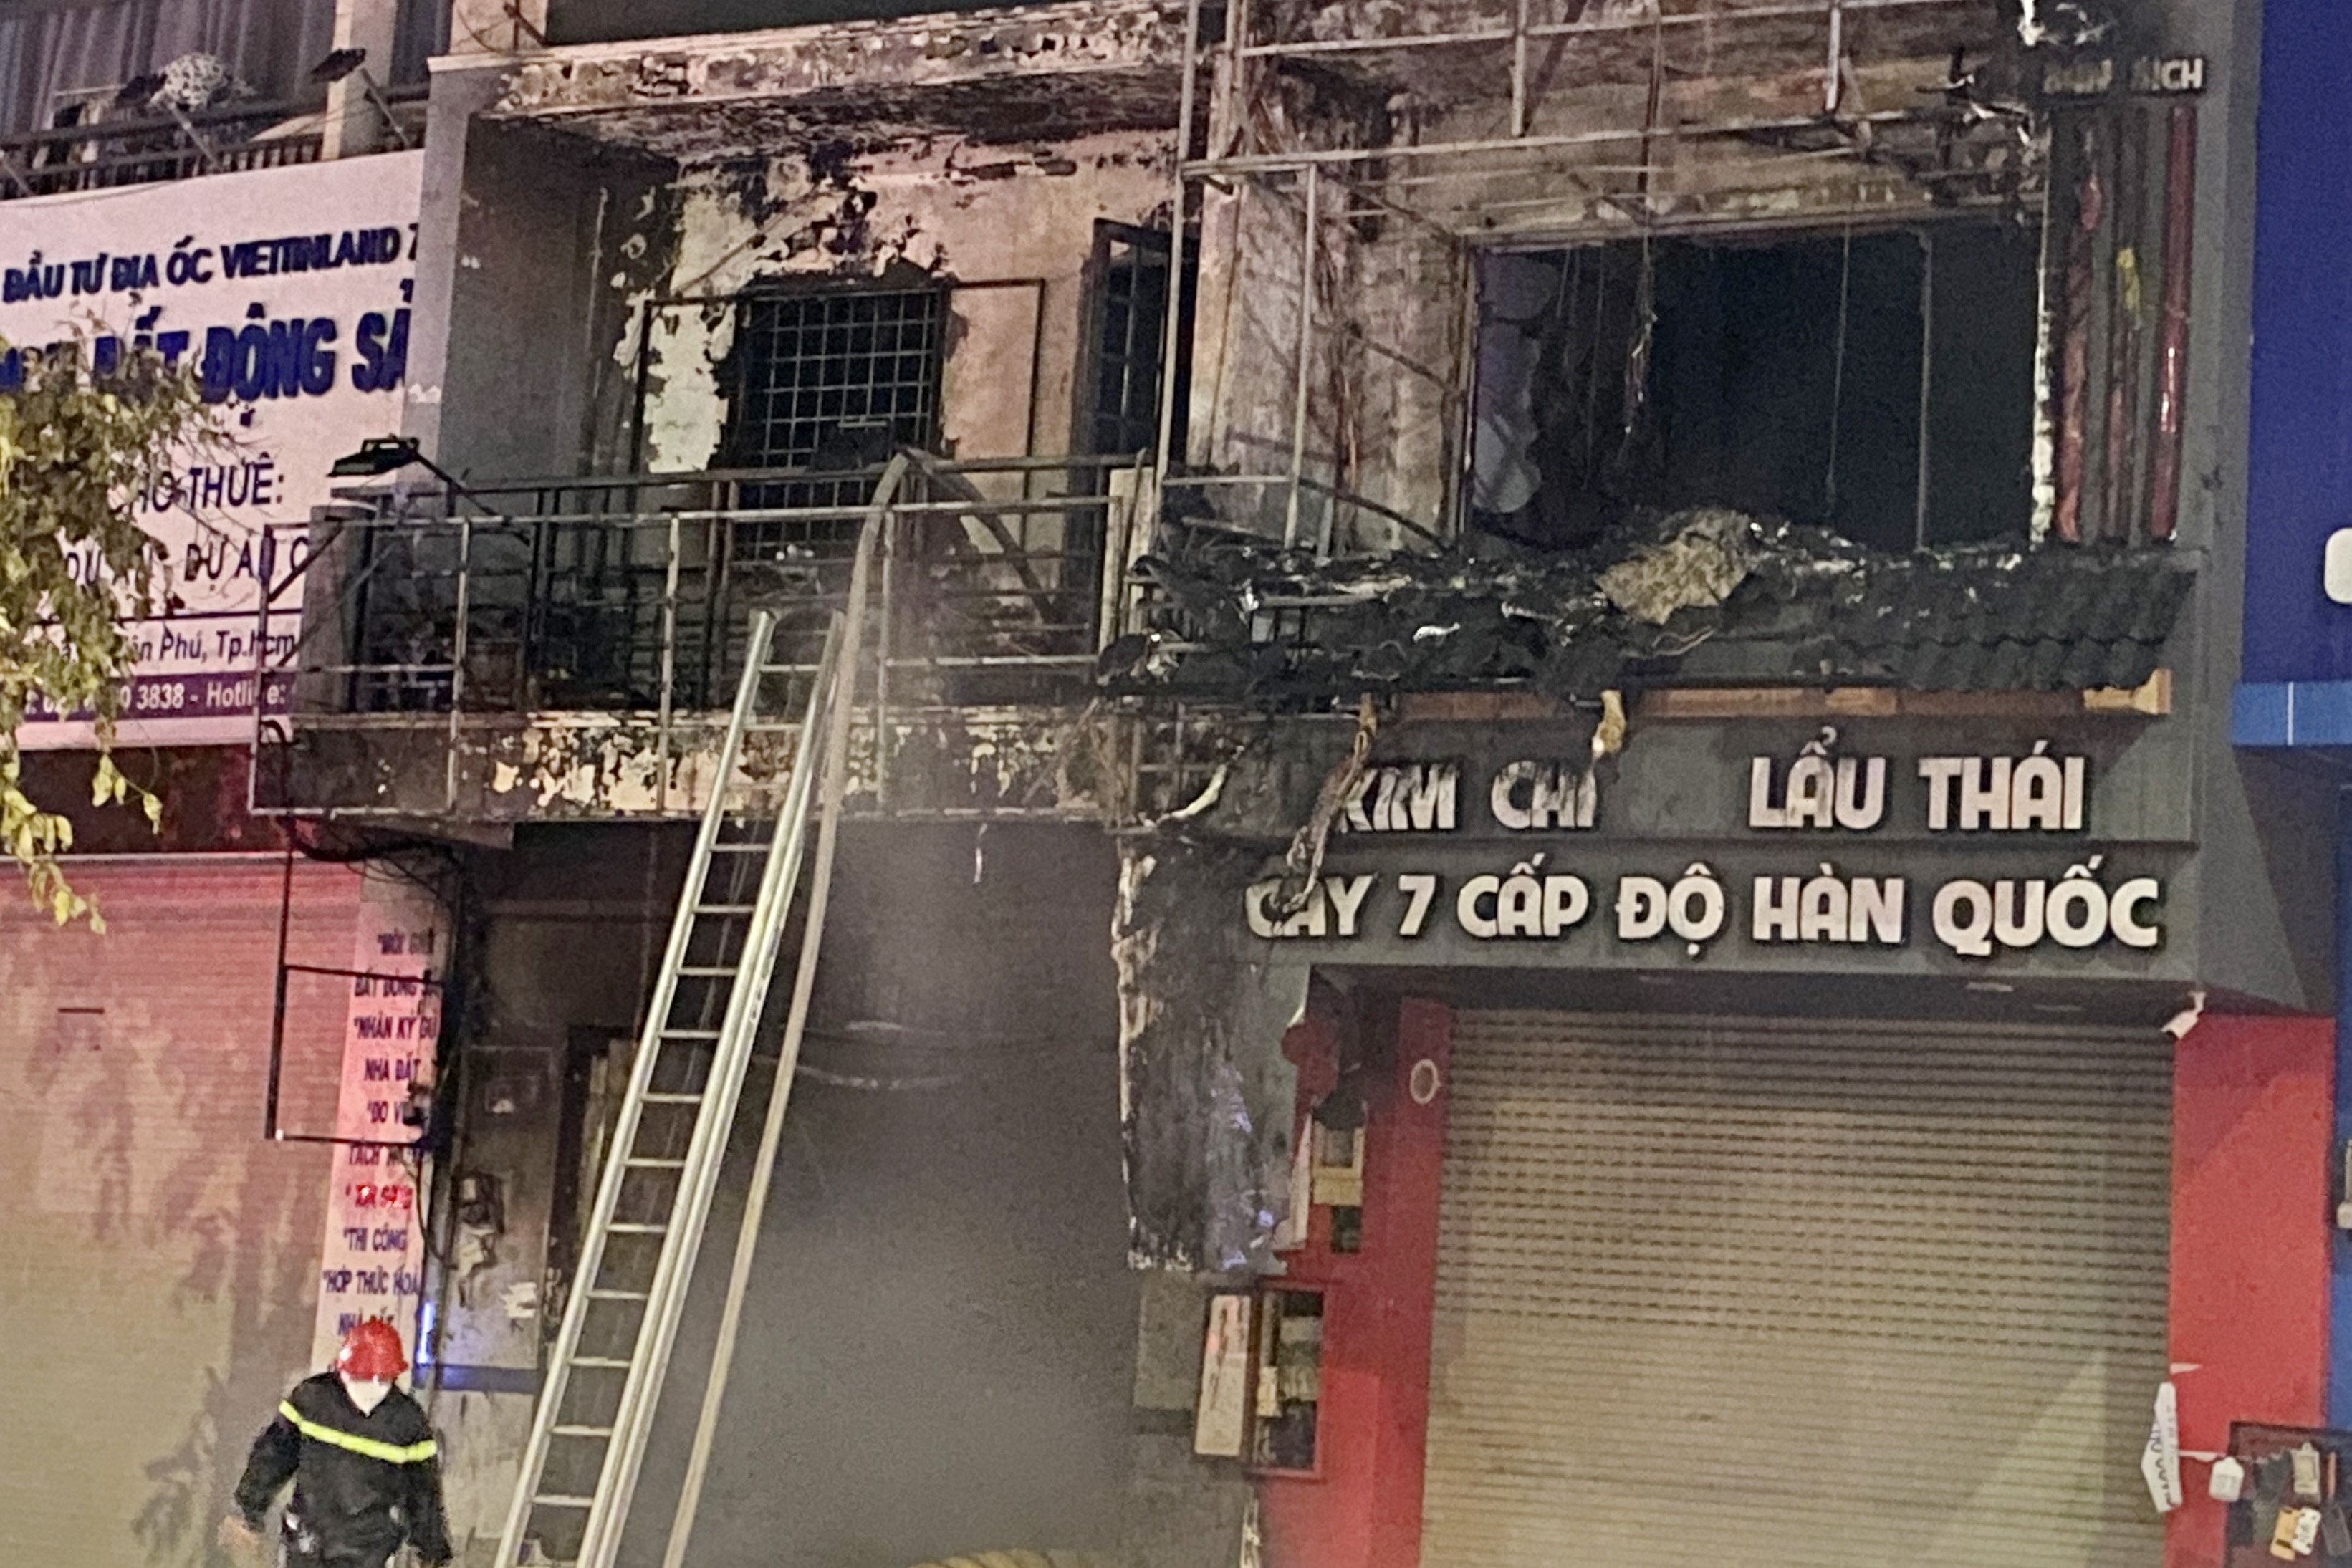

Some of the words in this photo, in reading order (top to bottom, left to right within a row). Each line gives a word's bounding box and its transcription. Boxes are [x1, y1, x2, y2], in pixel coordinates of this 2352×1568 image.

[166, 235, 213, 286] ỐC
[200, 302, 338, 427] ĐỘNG
[136, 683, 185, 711] 3838
[206, 678, 287, 708] Hotlie:
[1490, 760, 1598, 830] CHI
[1749, 725, 1886, 829] LẨU
[1918, 740, 2085, 830] THÁI
[1244, 873, 1373, 939] CAY
[1398, 874, 1436, 937] 7
[1456, 852, 1590, 939] CẤP
[1614, 861, 1725, 957] ĐỘ
[1752, 862, 1905, 945] HÀN
[1931, 854, 2159, 956] QUỐC
